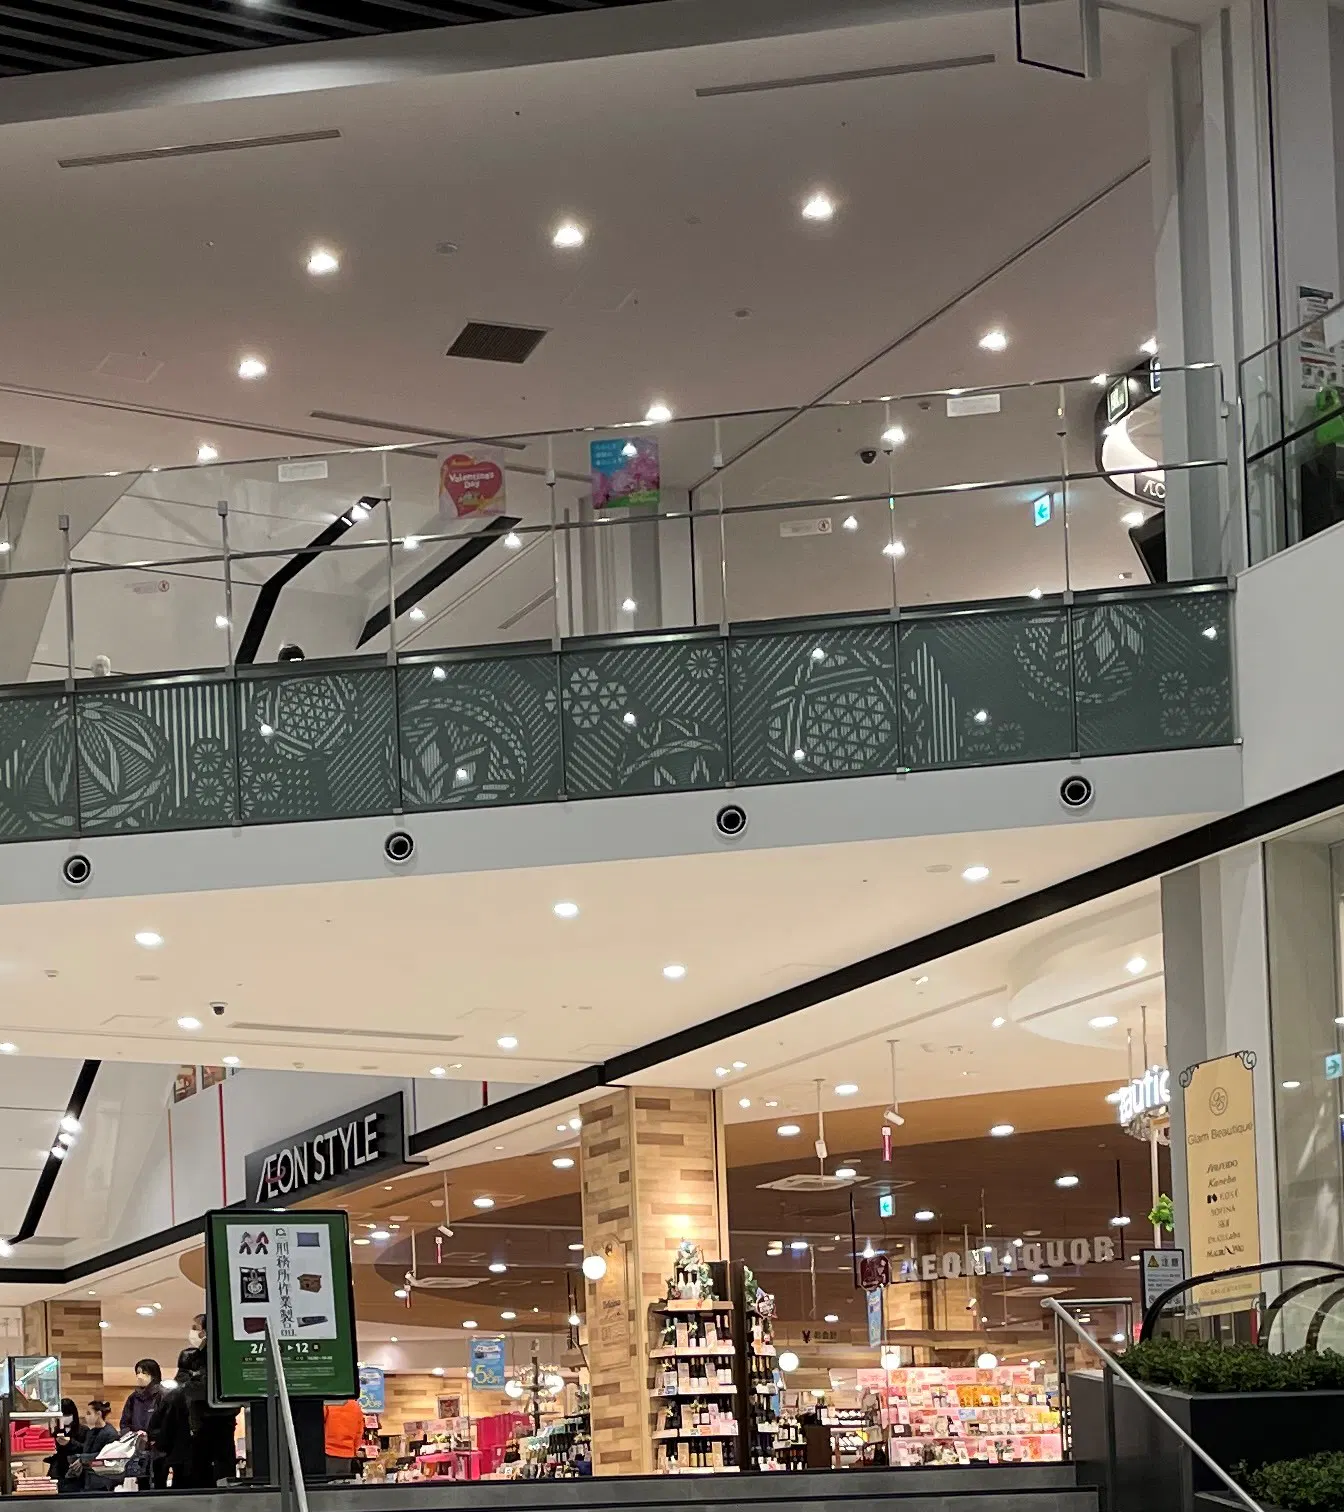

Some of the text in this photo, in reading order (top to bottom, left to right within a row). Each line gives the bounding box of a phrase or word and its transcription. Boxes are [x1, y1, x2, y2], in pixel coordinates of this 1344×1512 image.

[463, 480, 481, 490] Day
[1187, 1122, 1253, 1146] Glam Beautique
[313, 1112, 380, 1181] STYLE
[1207, 1174, 1237, 1188] Kanebo
[275, 1241, 297, 1337] 刑務所作業製品
[295, 1343, 309, 1353] 12
